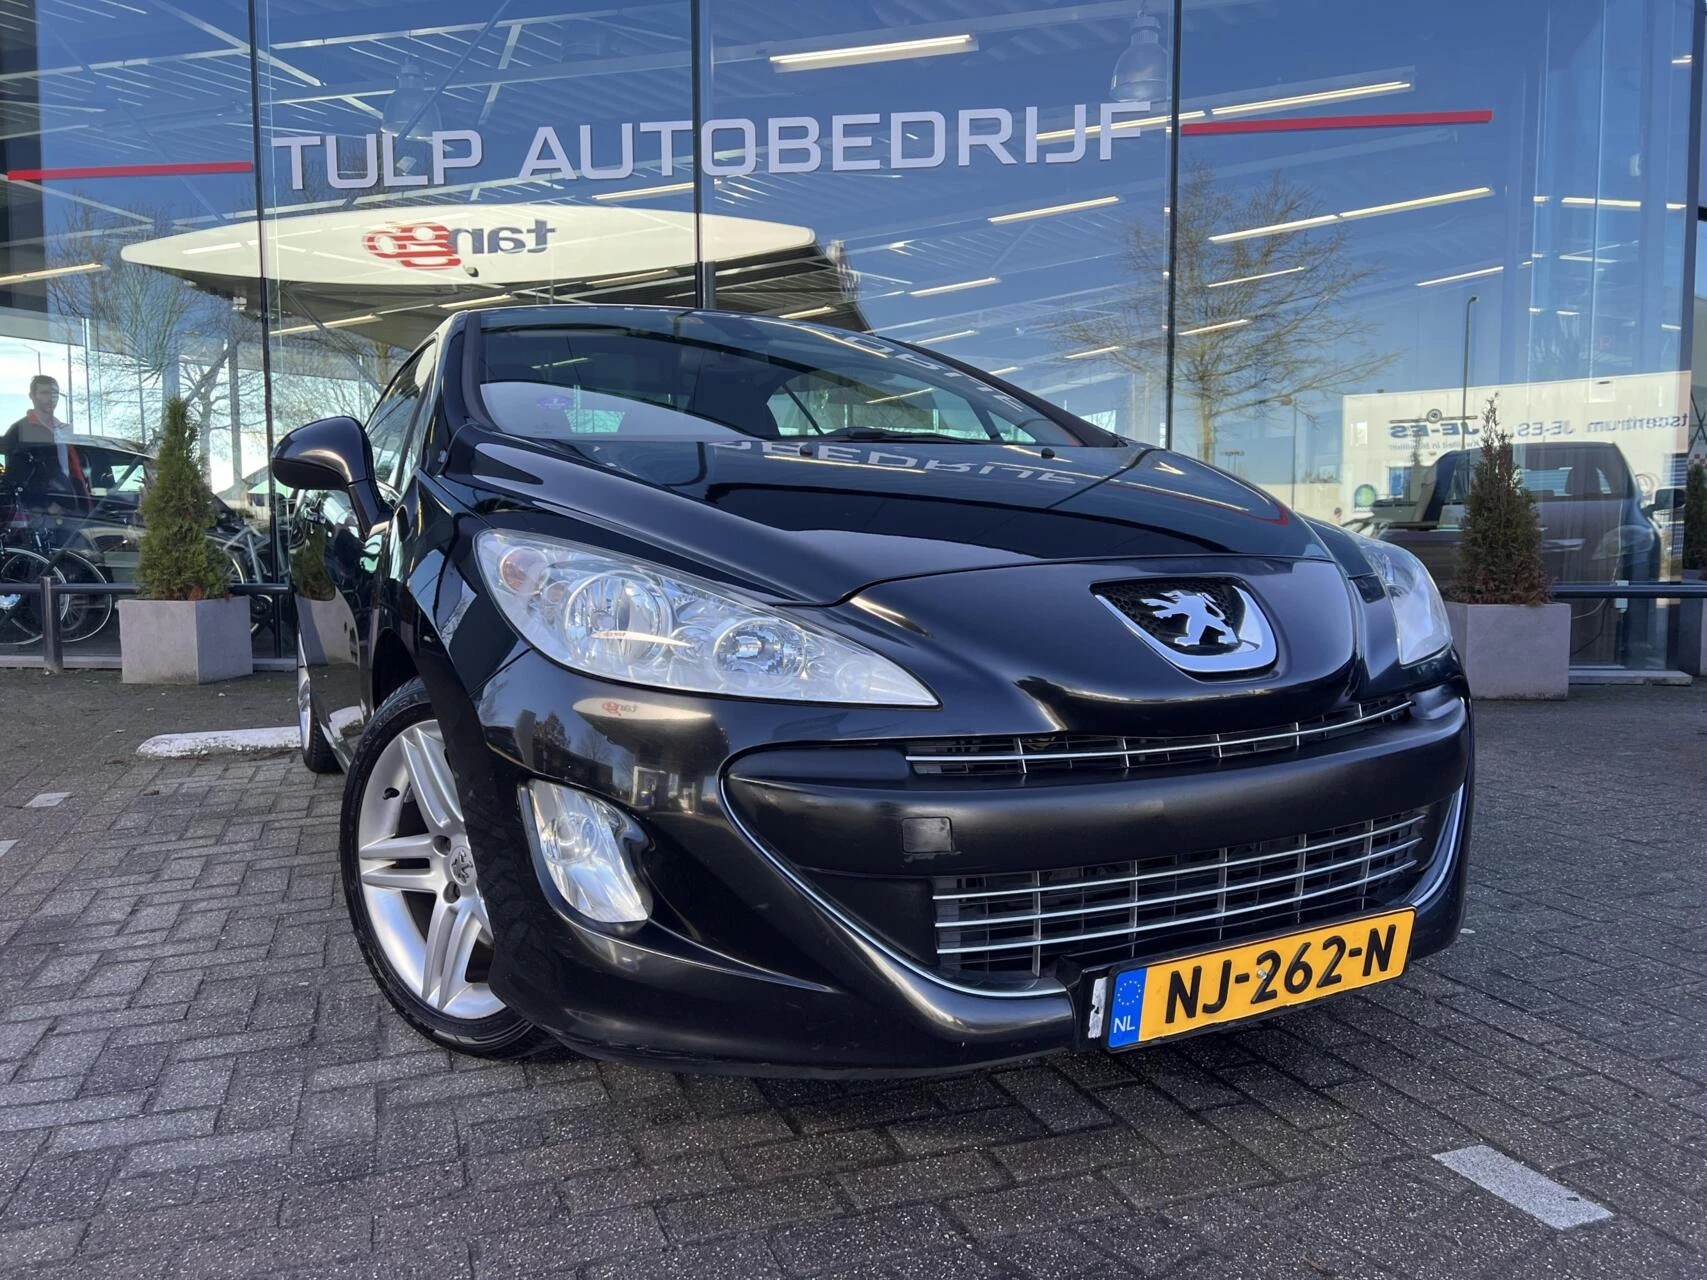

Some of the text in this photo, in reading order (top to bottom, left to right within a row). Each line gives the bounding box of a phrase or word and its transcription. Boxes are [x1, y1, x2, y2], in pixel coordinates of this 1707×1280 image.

[271, 101, 1151, 190] TULP AUTOBEDRIJF
[1165, 924, 1397, 1024] NJ-262-N
[1113, 1015, 1136, 1034] NL
